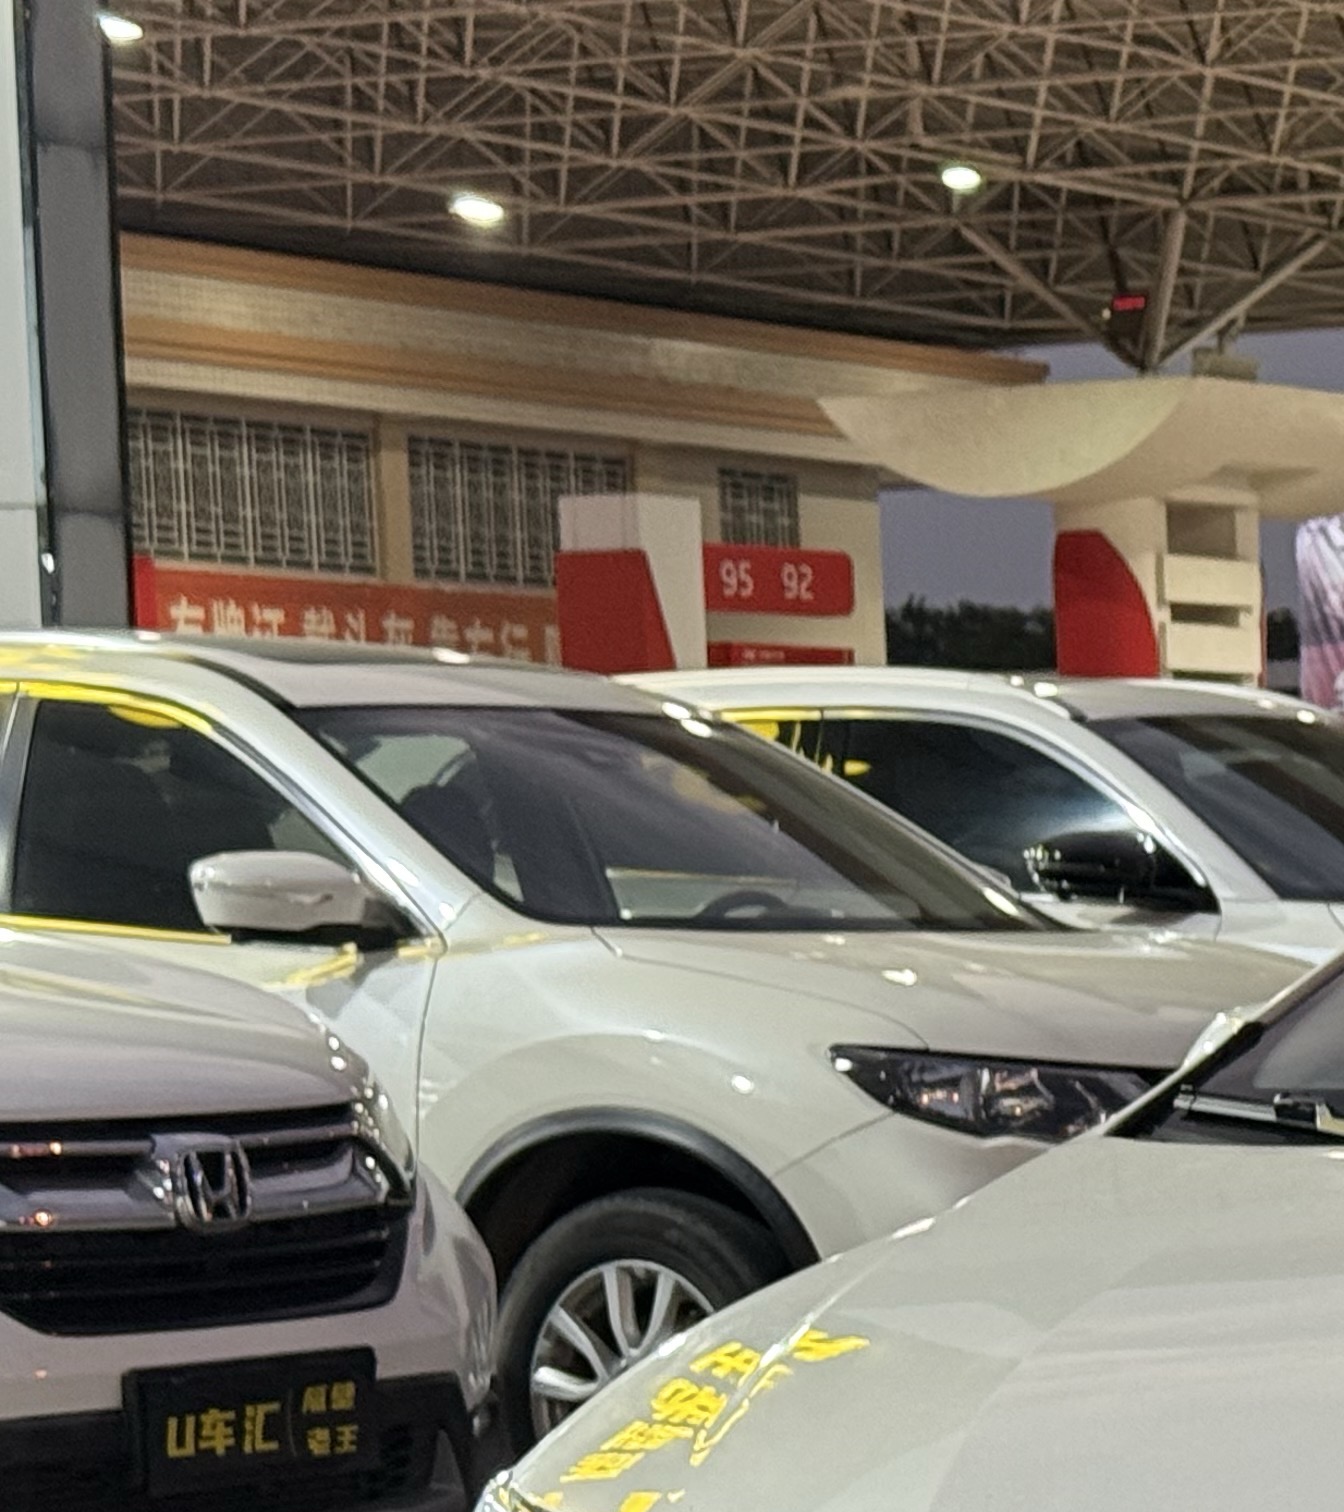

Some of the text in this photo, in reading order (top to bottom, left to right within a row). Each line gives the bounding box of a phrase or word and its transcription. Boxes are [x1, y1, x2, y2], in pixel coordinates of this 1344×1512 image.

[719, 559, 814, 600] 95 92
[167, 1402, 280, 1458] U车汇
